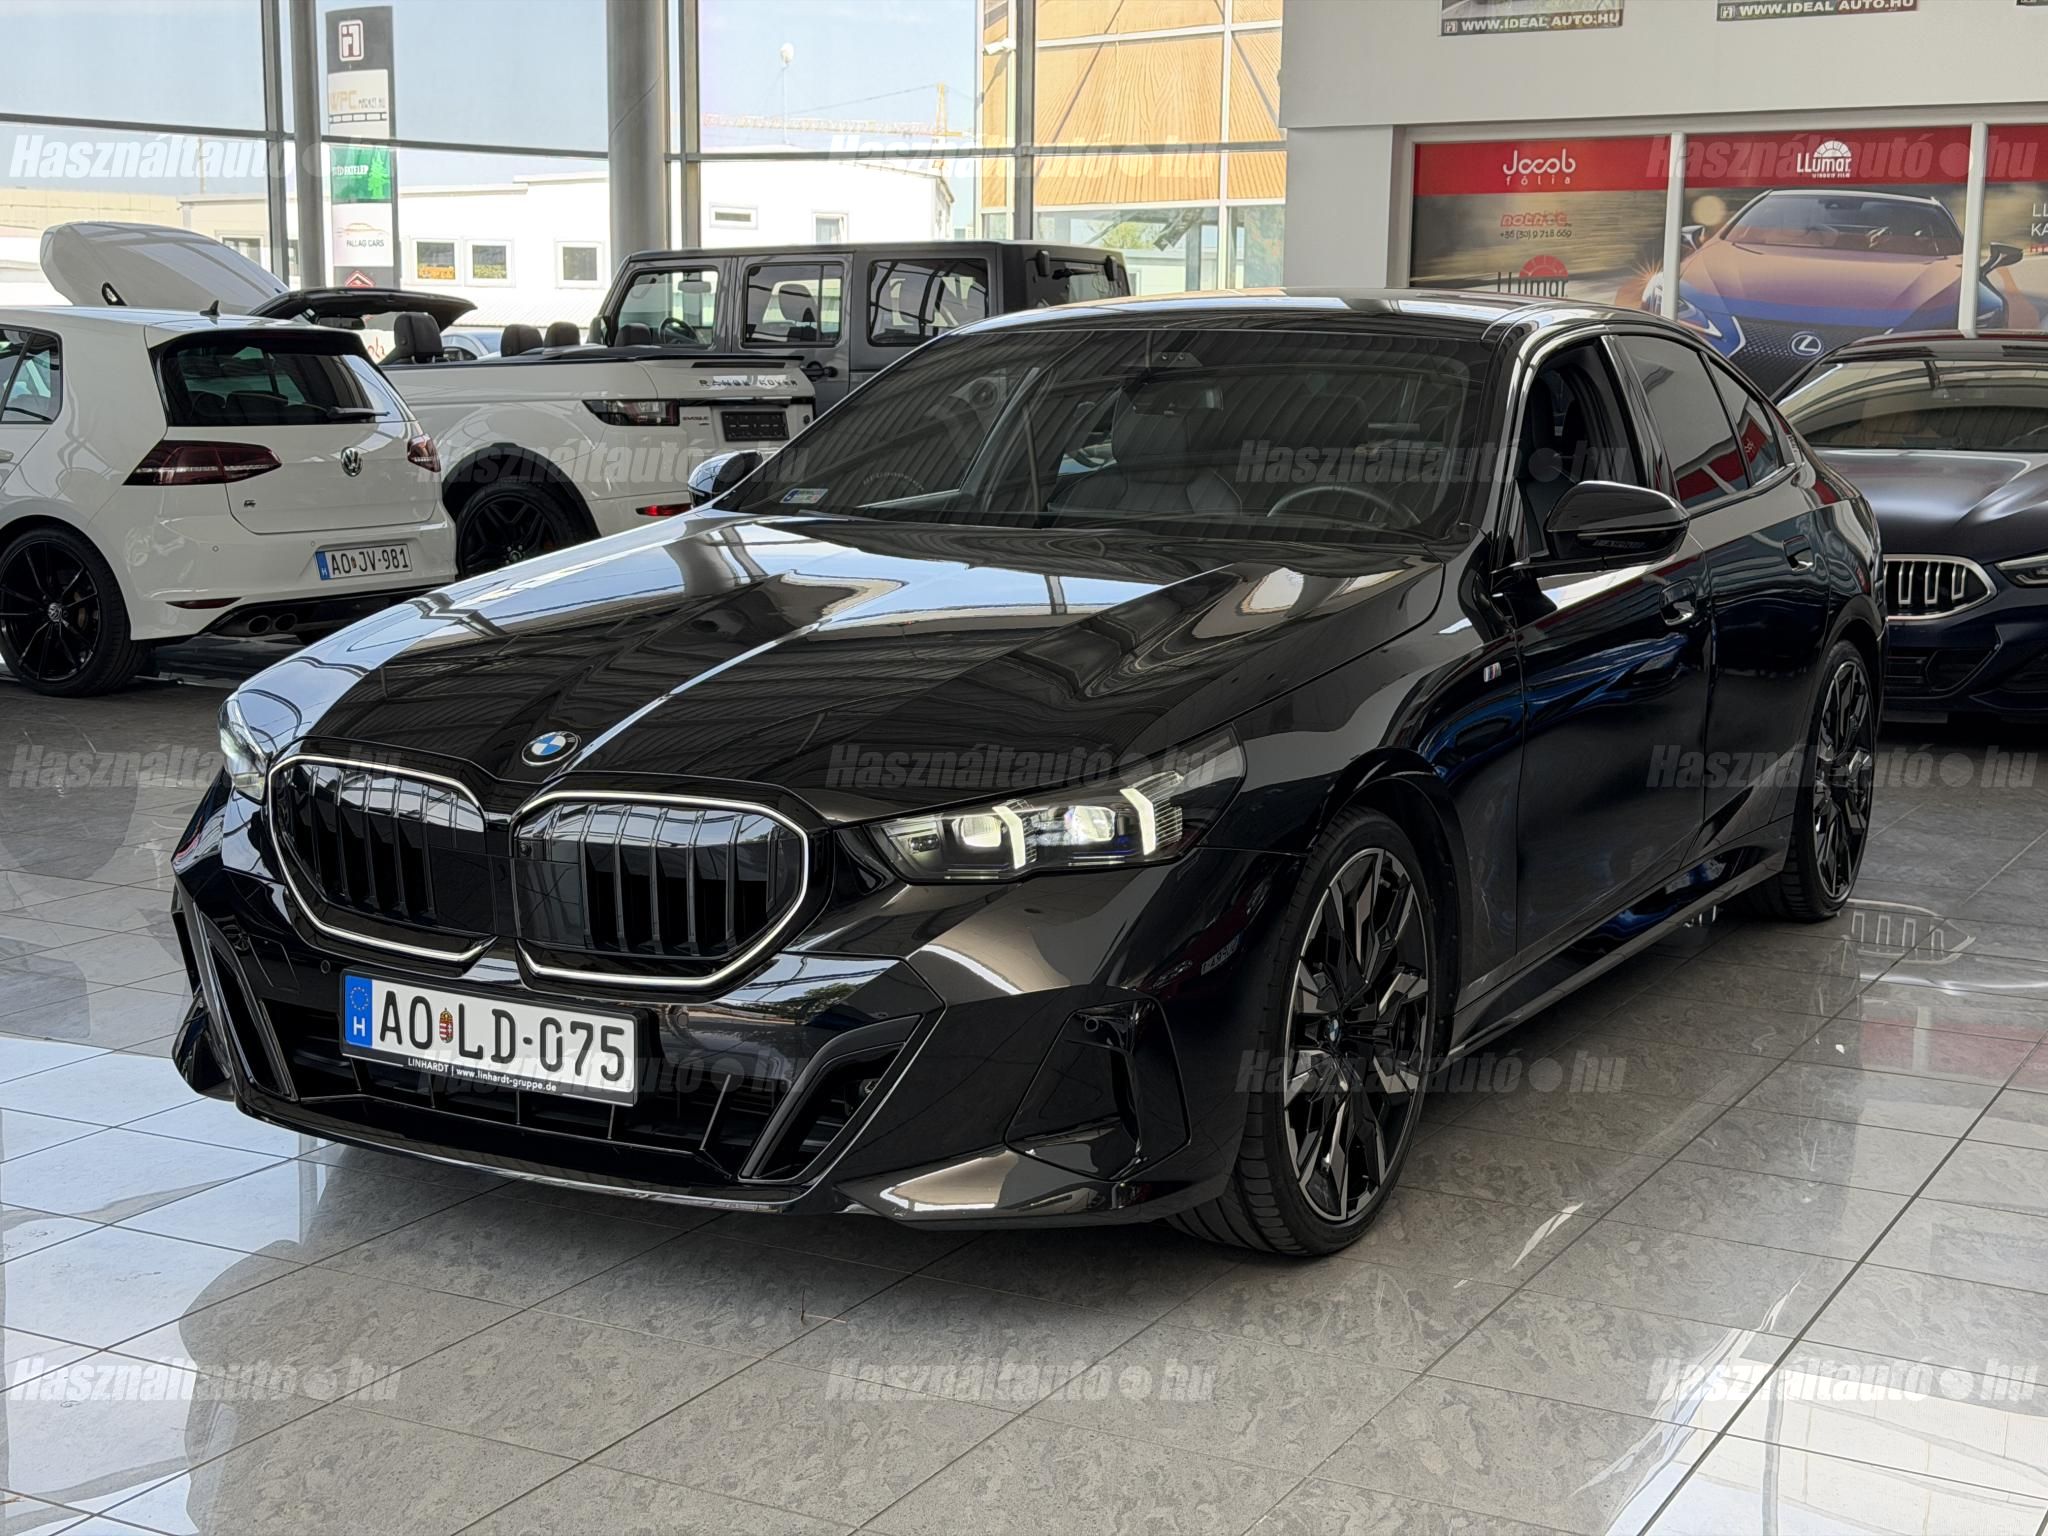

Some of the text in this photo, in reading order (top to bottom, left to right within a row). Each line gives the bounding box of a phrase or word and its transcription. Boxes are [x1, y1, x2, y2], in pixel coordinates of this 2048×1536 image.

[353, 1016, 366, 1037] H
[379, 989, 626, 1082] AO LD-075
[407, 1057, 557, 1093] LINHARDT www.linhardt-gruppe.de
